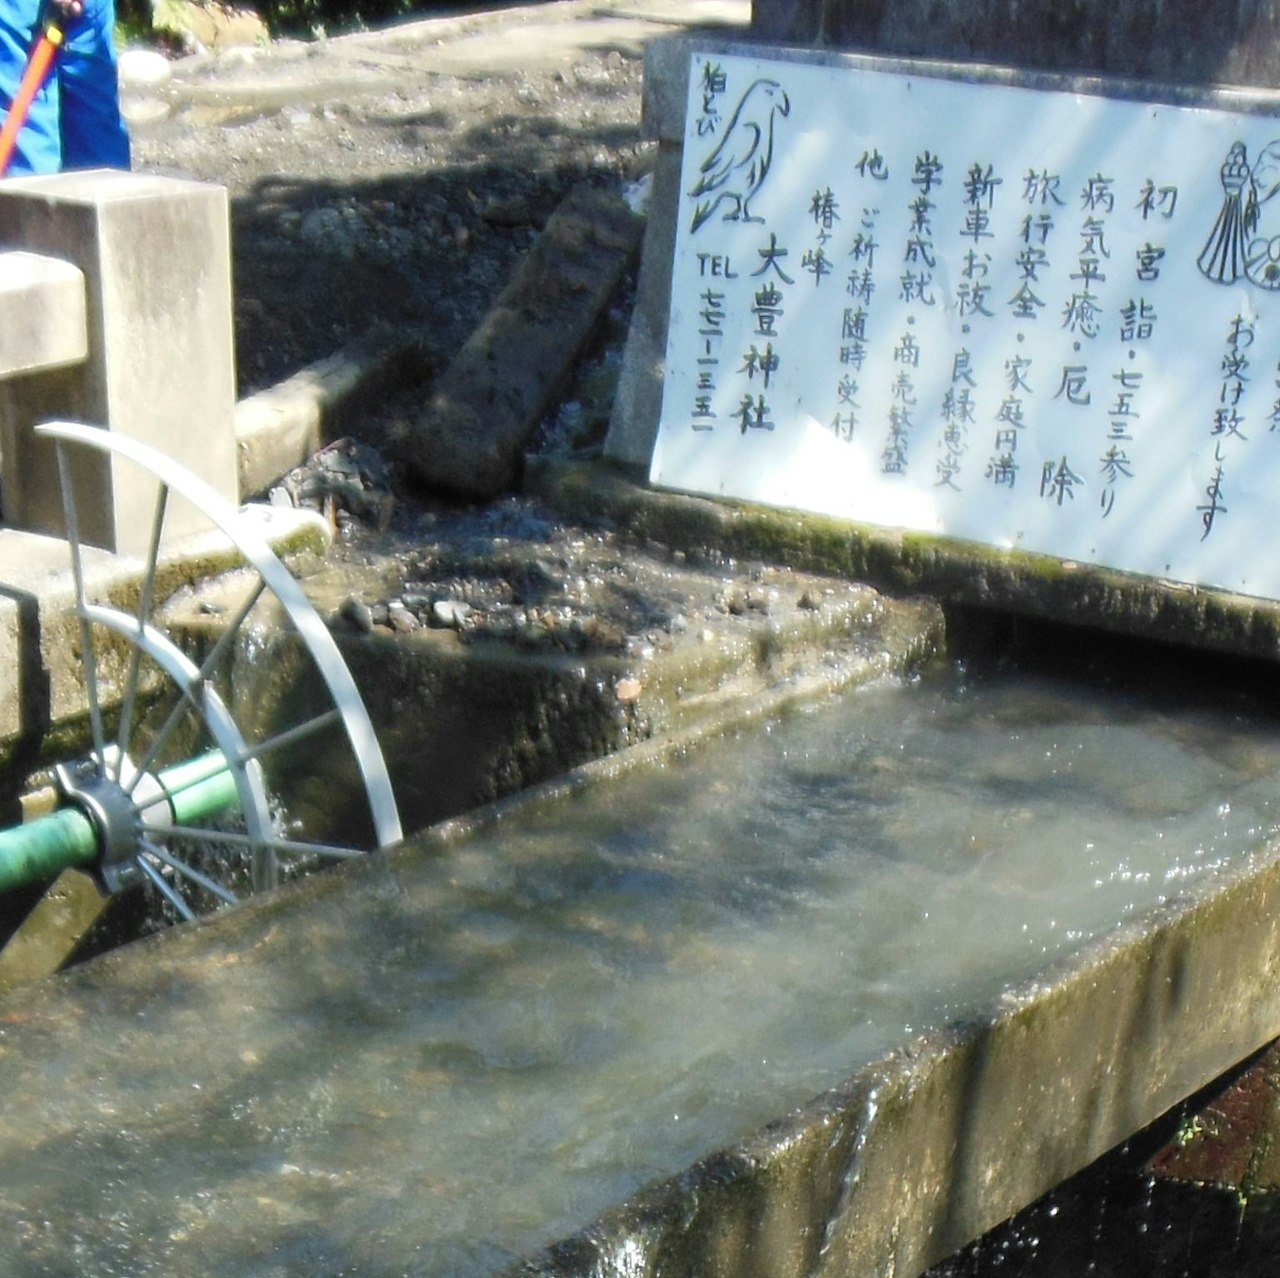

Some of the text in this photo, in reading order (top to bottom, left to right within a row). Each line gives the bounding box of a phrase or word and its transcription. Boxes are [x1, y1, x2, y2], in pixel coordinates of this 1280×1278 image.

[696, 252, 739, 280] TEL
[729, 232, 795, 435] 大豊神社
[830, 148, 890, 443] 他 ご祈祷随時受付
[1196, 313, 1258, 542] お受け致します
